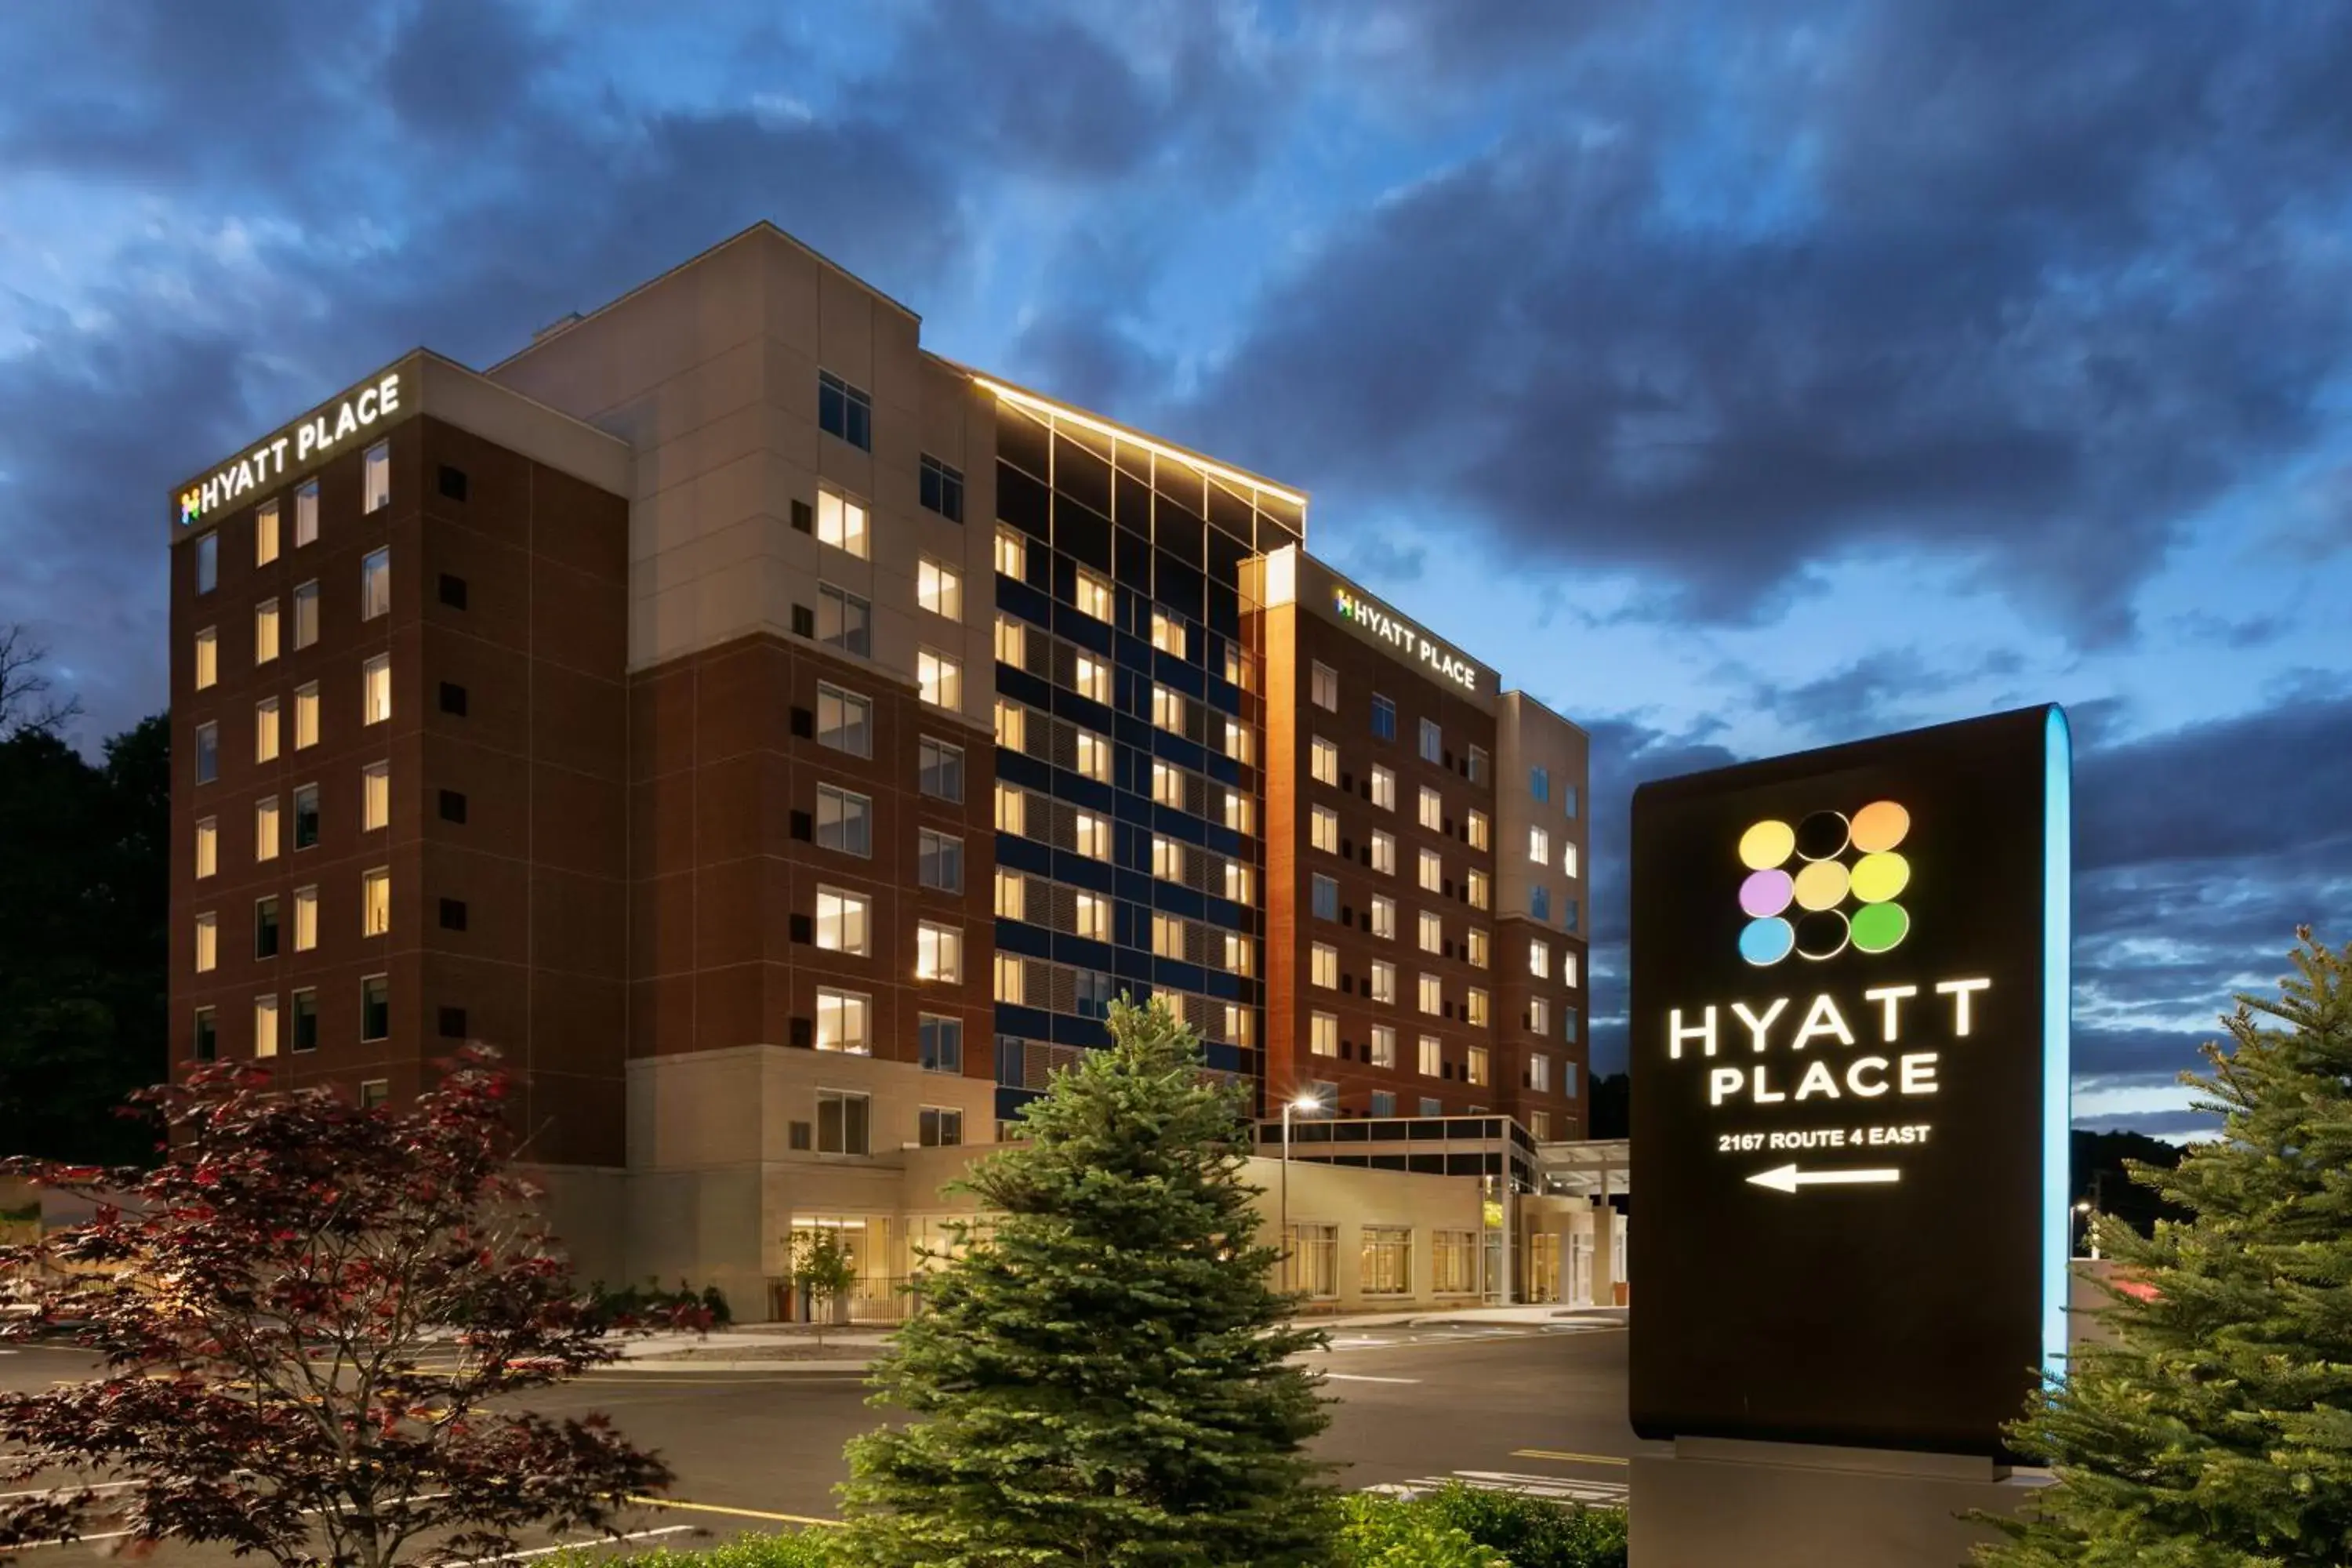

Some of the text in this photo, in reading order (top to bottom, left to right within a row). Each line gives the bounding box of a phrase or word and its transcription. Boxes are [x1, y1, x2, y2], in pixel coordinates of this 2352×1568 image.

[201, 372, 400, 514] HYATT PLACE
[1354, 599, 1475, 691] HYATT PLACE
[1669, 977, 1991, 1060] HYATT
[1709, 1051, 1940, 1107] PLACE
[1718, 1124, 1932, 1152] 2167 ROUTE 4 EAST
